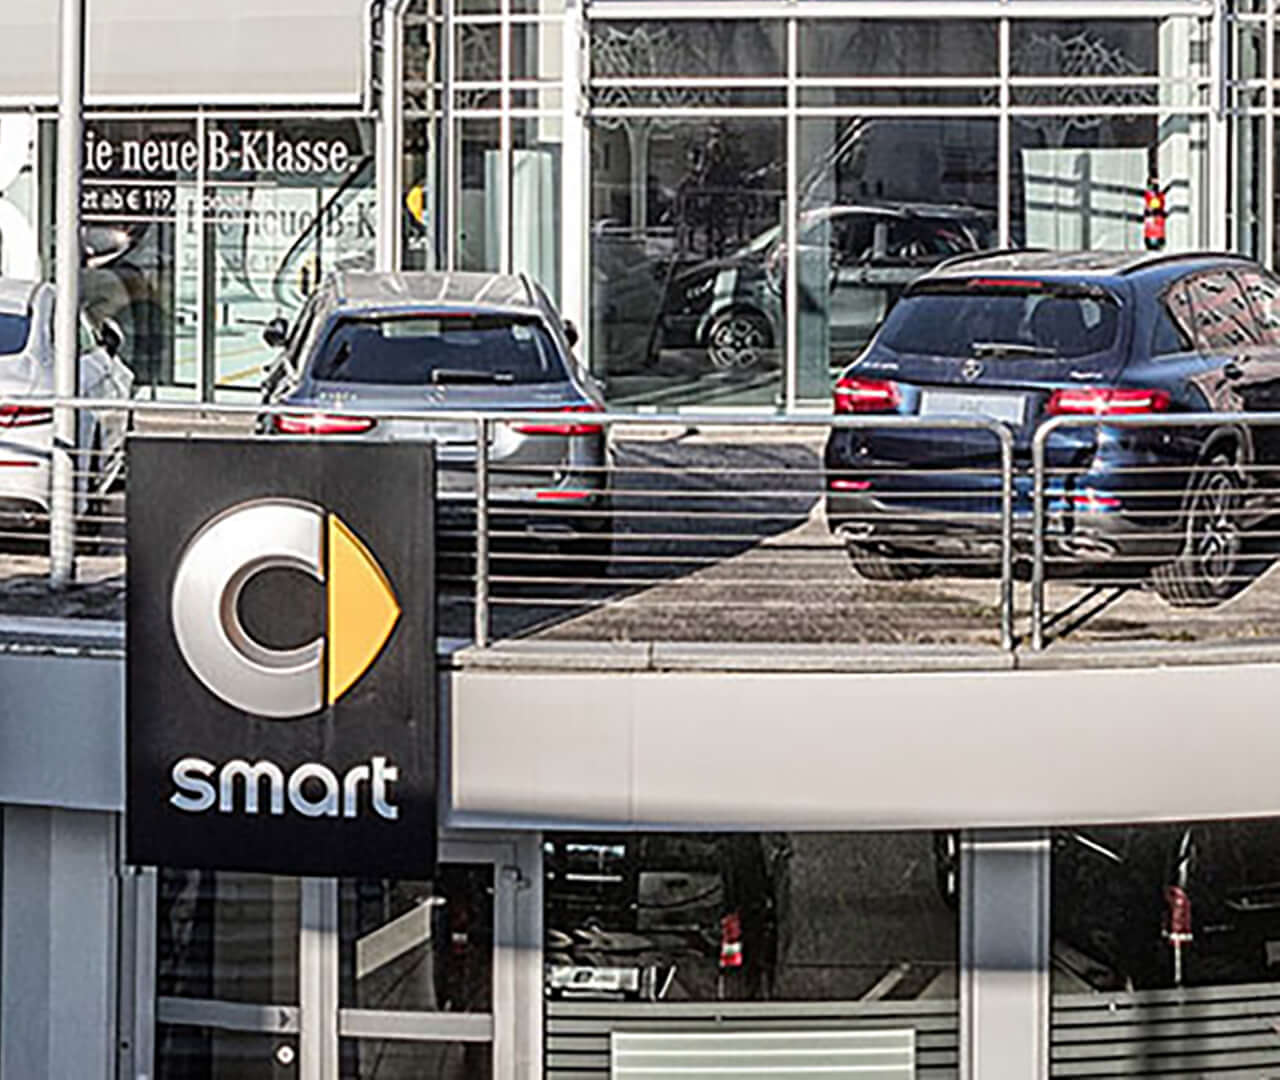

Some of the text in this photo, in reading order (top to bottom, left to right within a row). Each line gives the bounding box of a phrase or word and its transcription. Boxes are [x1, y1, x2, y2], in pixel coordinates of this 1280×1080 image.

[83, 129, 358, 172] ie neue B-Klasse.
[170, 756, 400, 819] smart
